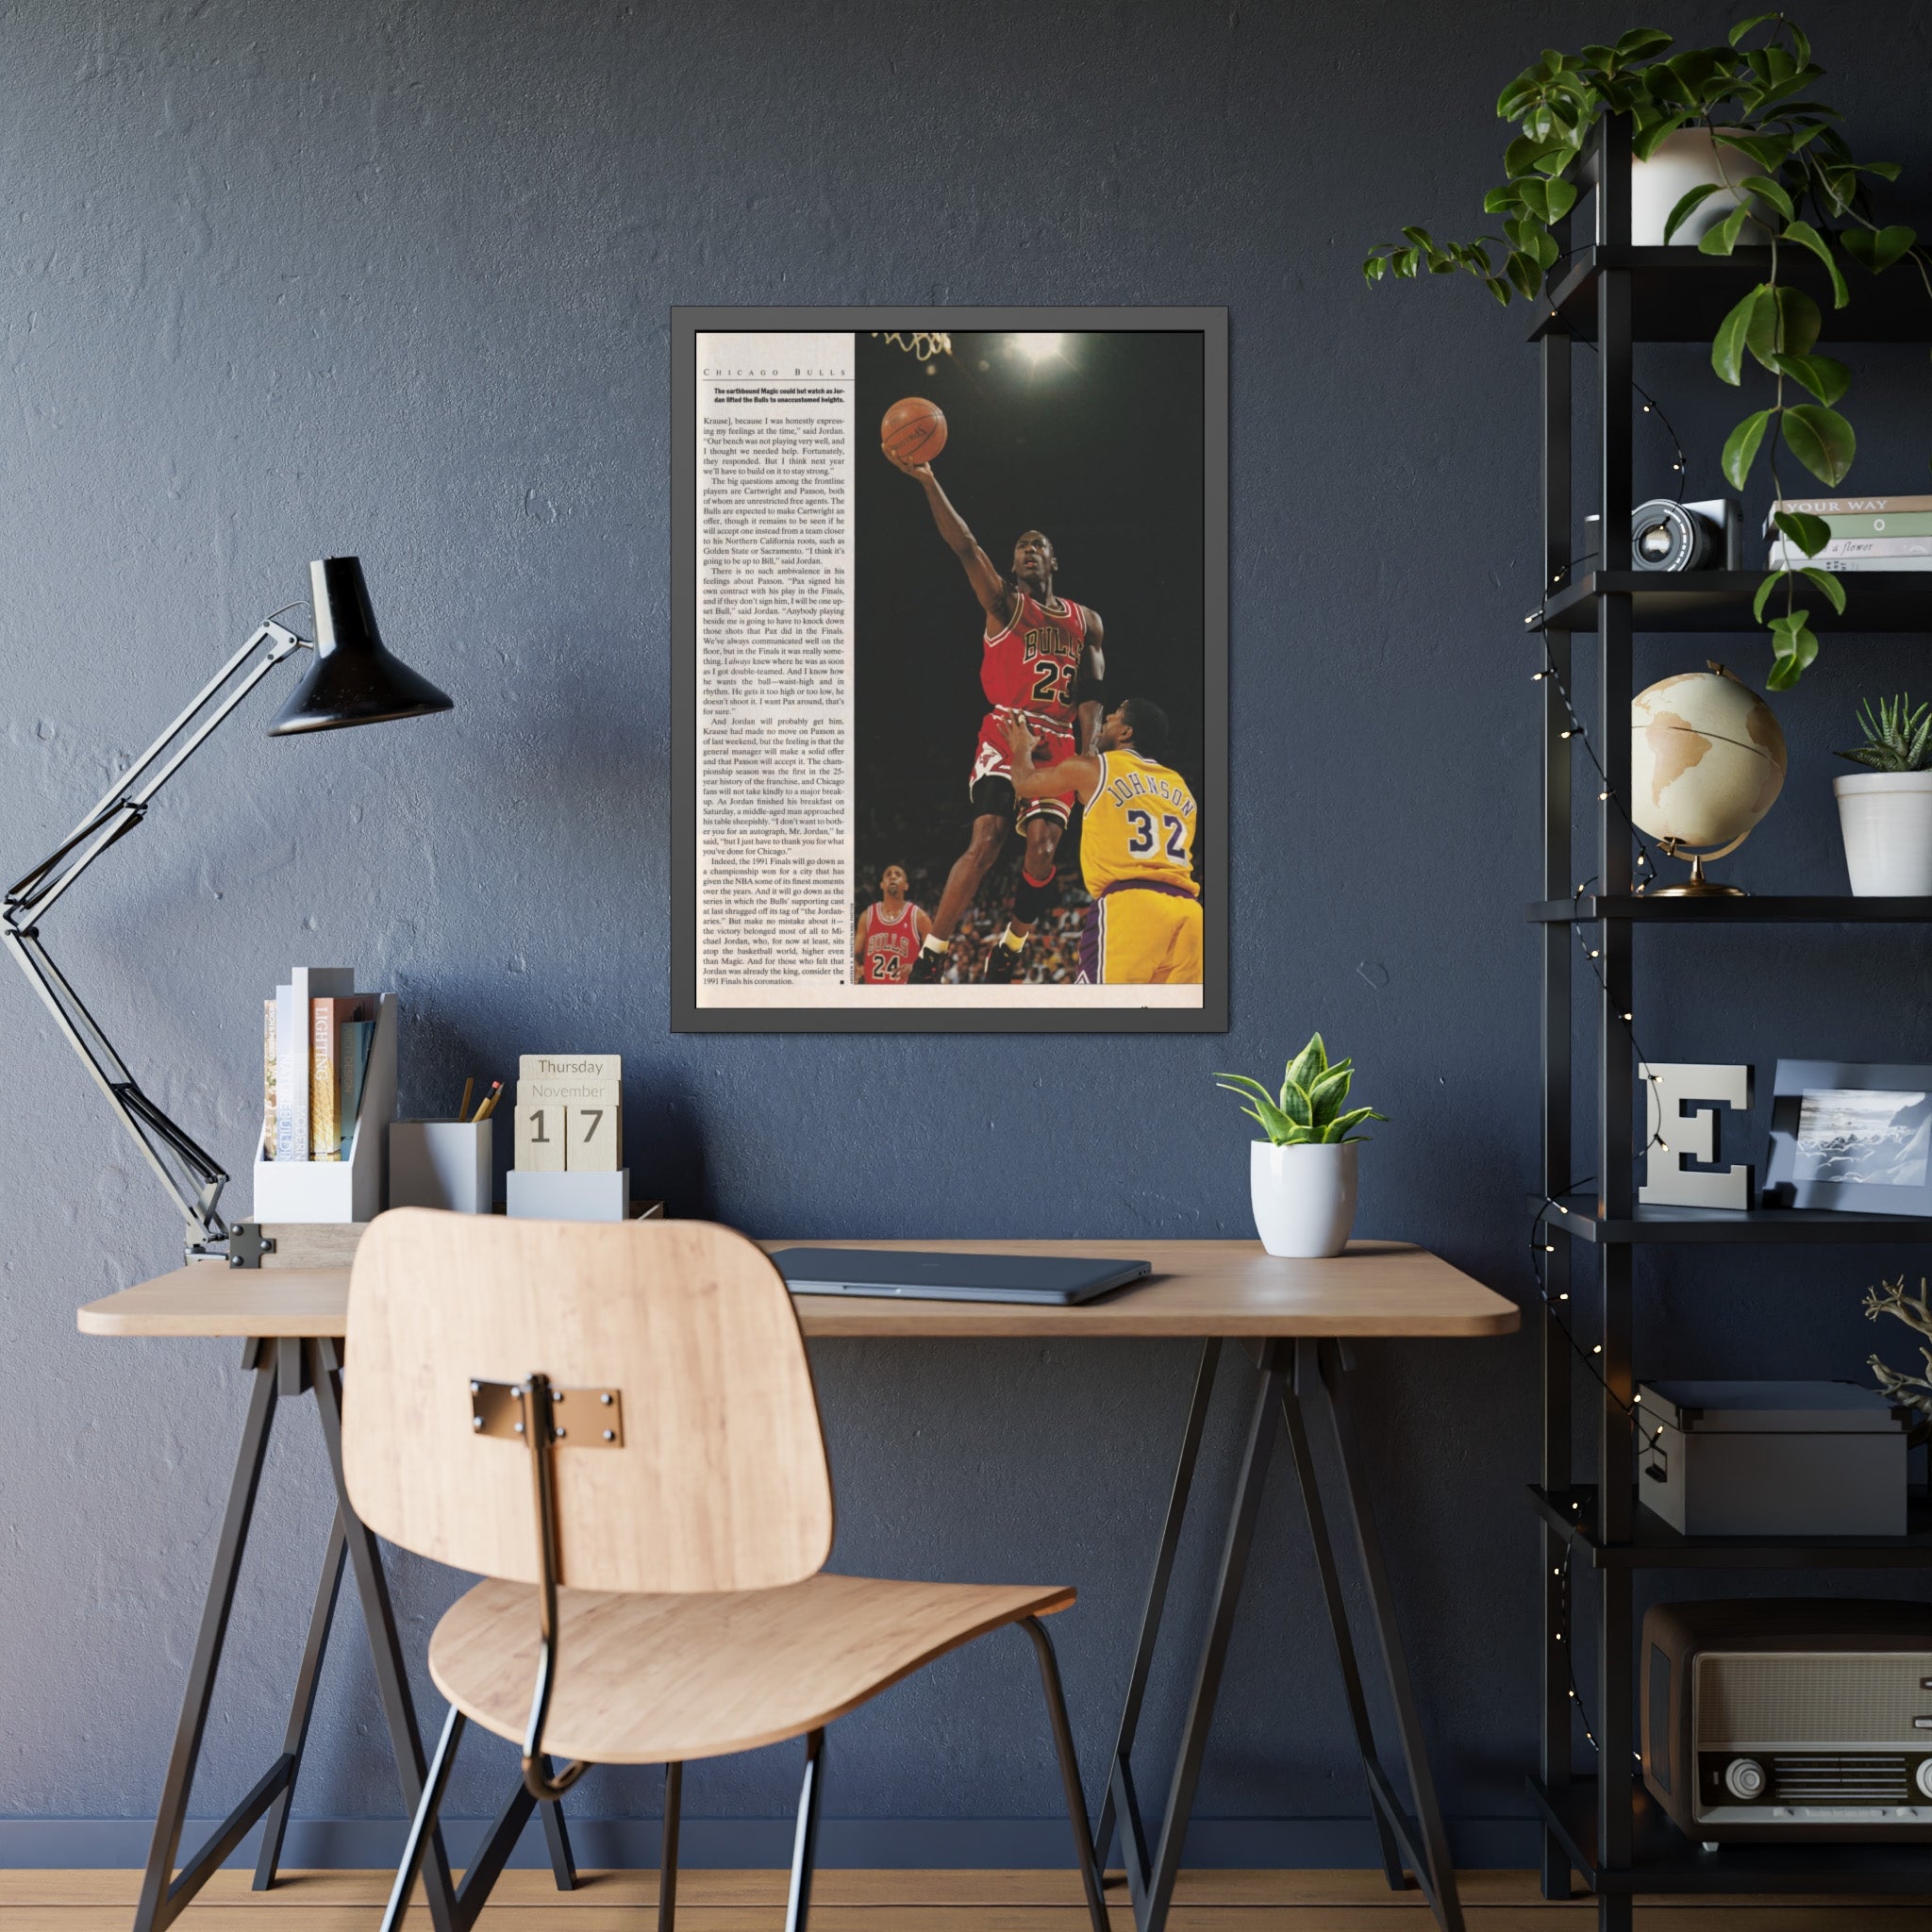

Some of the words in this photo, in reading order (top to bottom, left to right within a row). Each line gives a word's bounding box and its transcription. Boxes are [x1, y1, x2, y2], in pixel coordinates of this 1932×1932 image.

[710, 447, 737, 456] thought
[704, 457, 718, 466] they
[727, 477, 739, 486] big
[740, 477, 773, 486] questions
[704, 487, 728, 496] players
[743, 487, 782, 496] Cartwright
[735, 507, 766, 516] expected
[796, 507, 834, 516] Cartwright
[1786, 502, 1840, 512] YOUR
[1848, 500, 1888, 510] WAY
[1840, 541, 1874, 556] flower
[781, 587, 795, 596] play
[1031, 659, 1077, 708] 23
[778, 717, 808, 726] probably
[813, 718, 824, 726] get
[703, 747, 729, 756] general
[703, 767, 733, 776] pionship
[1107, 772, 1194, 818] JOHNSON
[1127, 809, 1189, 866] 32
[710, 867, 759, 876] championship
[799, 867, 812, 876] city
[703, 948, 719, 956] atop
[802, 947, 824, 956] higher
[867, 933, 909, 958] BULLS
[872, 953, 901, 980] 24
[315, 1007, 328, 1080] LIGHTING
[539, 1060, 604, 1075] Thursday
[344, 1057, 353, 1093] DESIGN
[532, 1085, 605, 1098] November
[296, 1105, 306, 1161] MODERN
